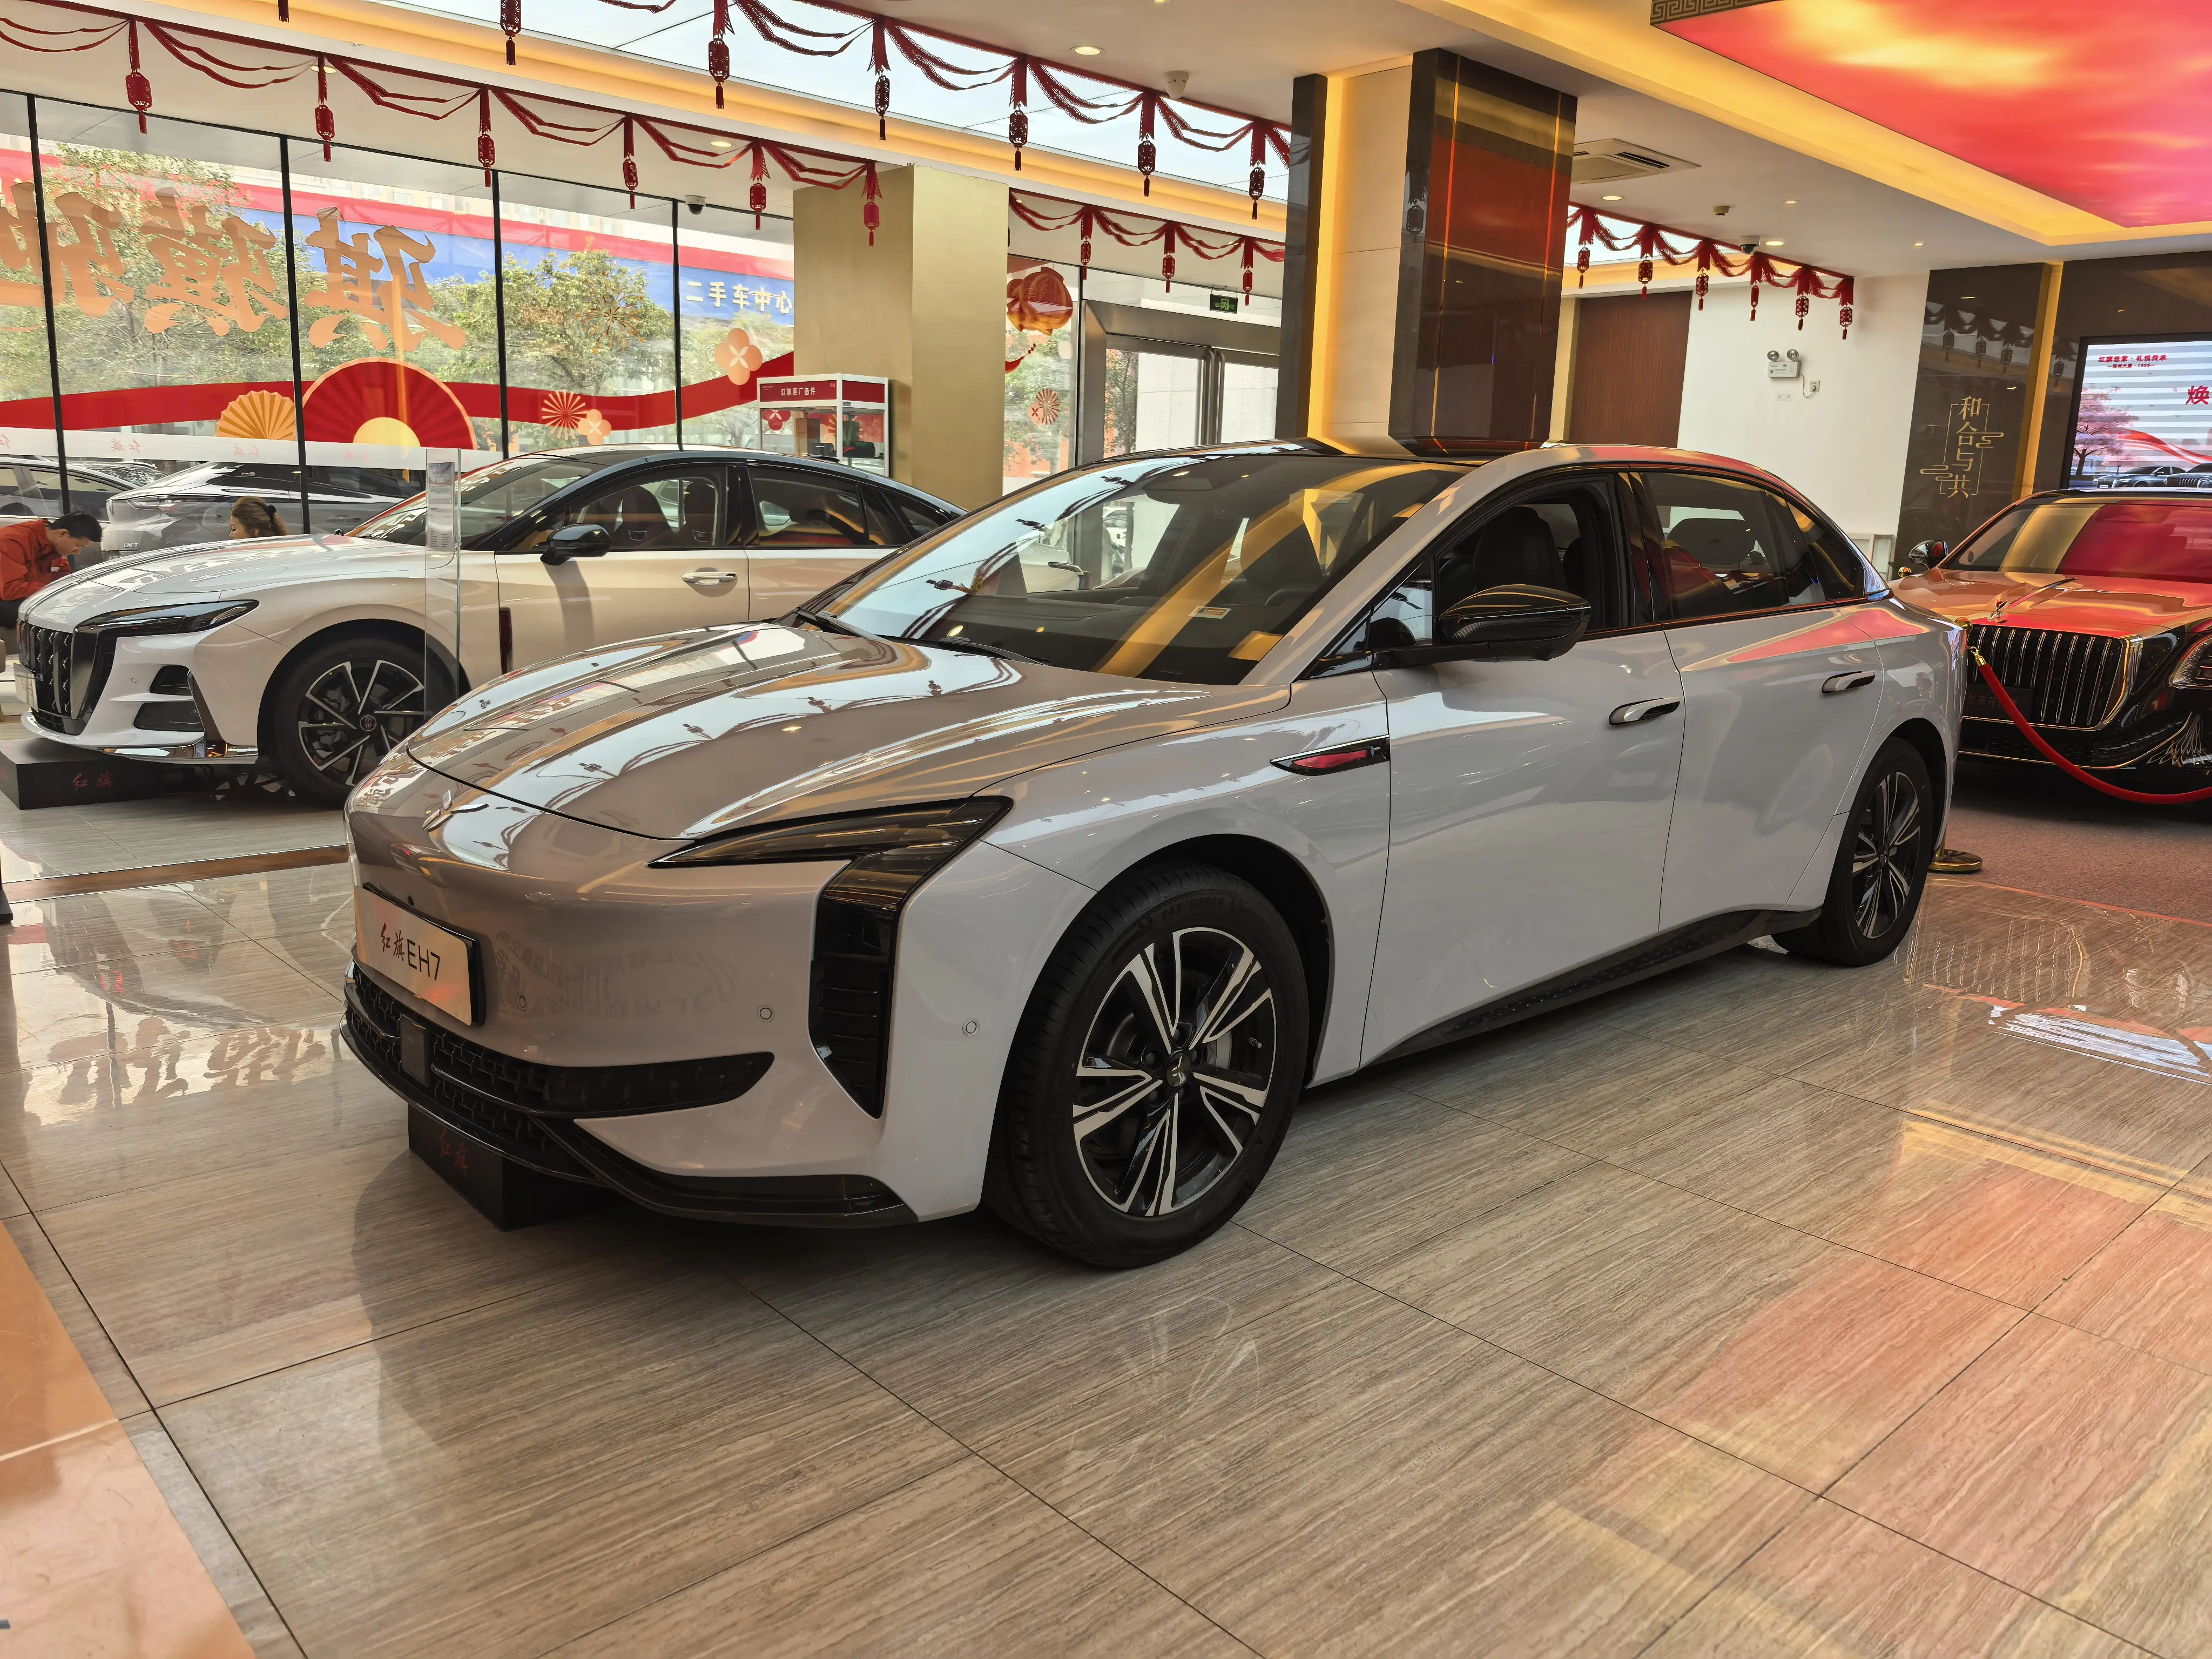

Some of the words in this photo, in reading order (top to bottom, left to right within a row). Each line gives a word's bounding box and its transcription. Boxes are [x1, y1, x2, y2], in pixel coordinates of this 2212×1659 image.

[685, 281, 793, 314] 二手车中心
[2186, 385, 2210, 404] 焕
[1947, 396, 1981, 498] 和合与共
[72, 770, 113, 791] 红旗
